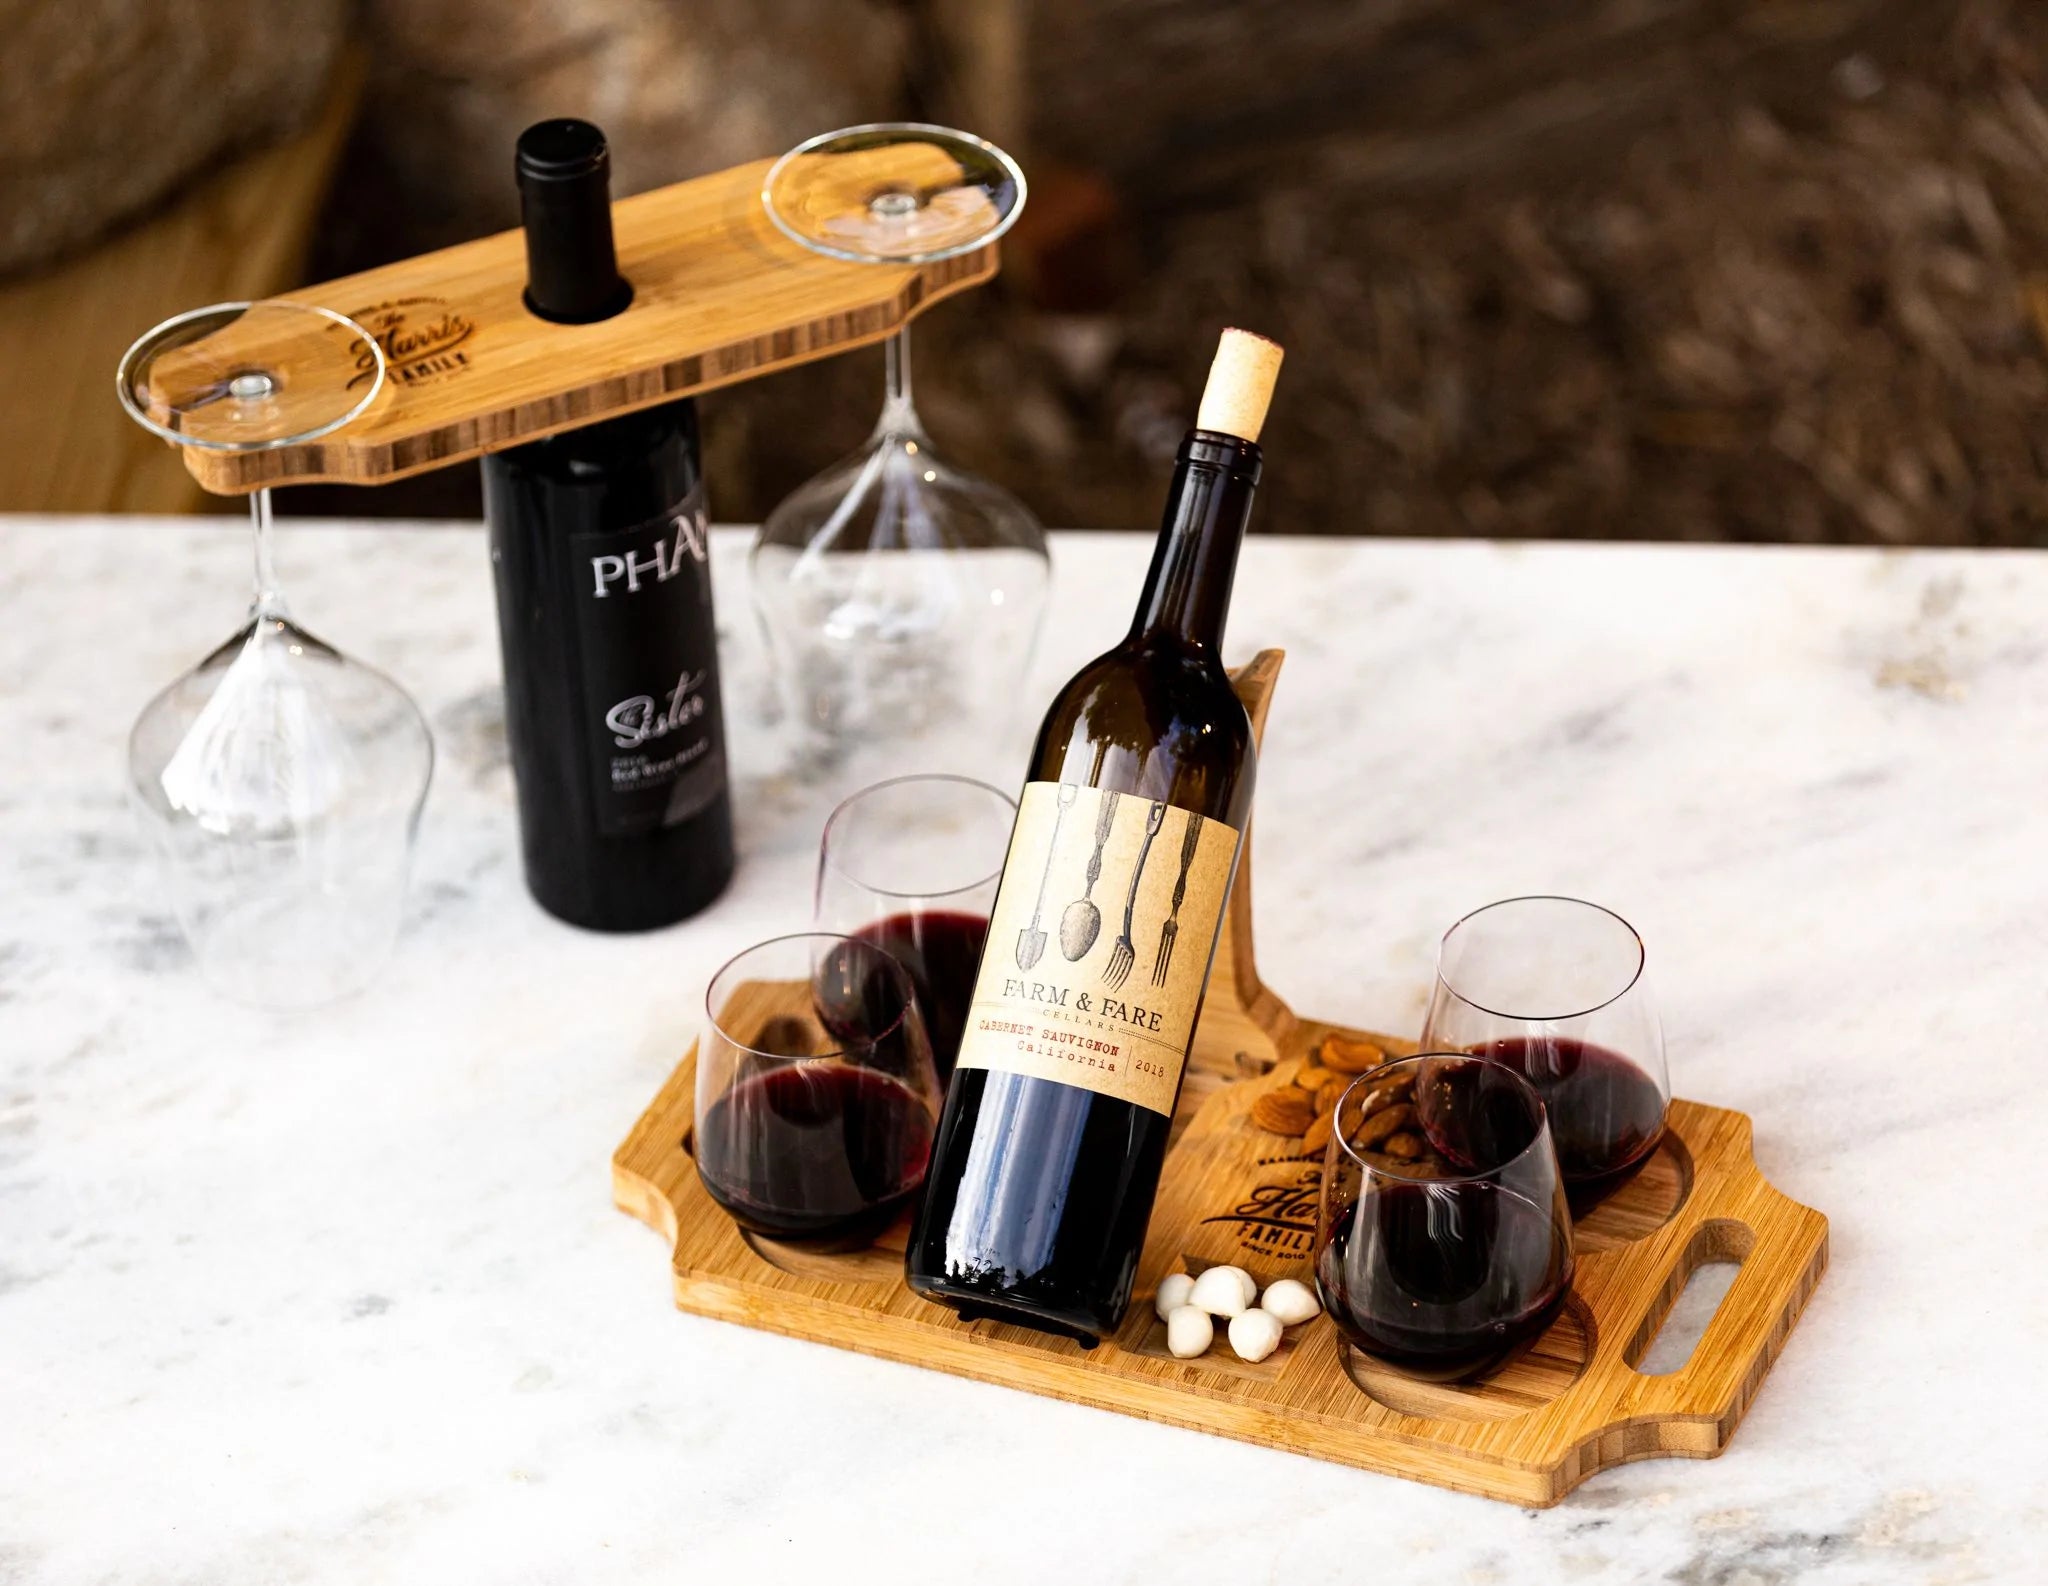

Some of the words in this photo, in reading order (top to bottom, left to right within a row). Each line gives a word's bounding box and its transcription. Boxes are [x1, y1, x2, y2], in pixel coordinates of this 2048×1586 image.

[1002, 978, 1070, 1007] FARM
[1075, 992, 1093, 1012] &
[1099, 997, 1163, 1033] FARE
[1042, 1008, 1115, 1032] CELLARS
[979, 1019, 1034, 1036] CABERNET
[1041, 1029, 1121, 1057] SAUVIGNON
[1017, 1040, 1116, 1073] California
[1134, 1059, 1165, 1079] 2018
